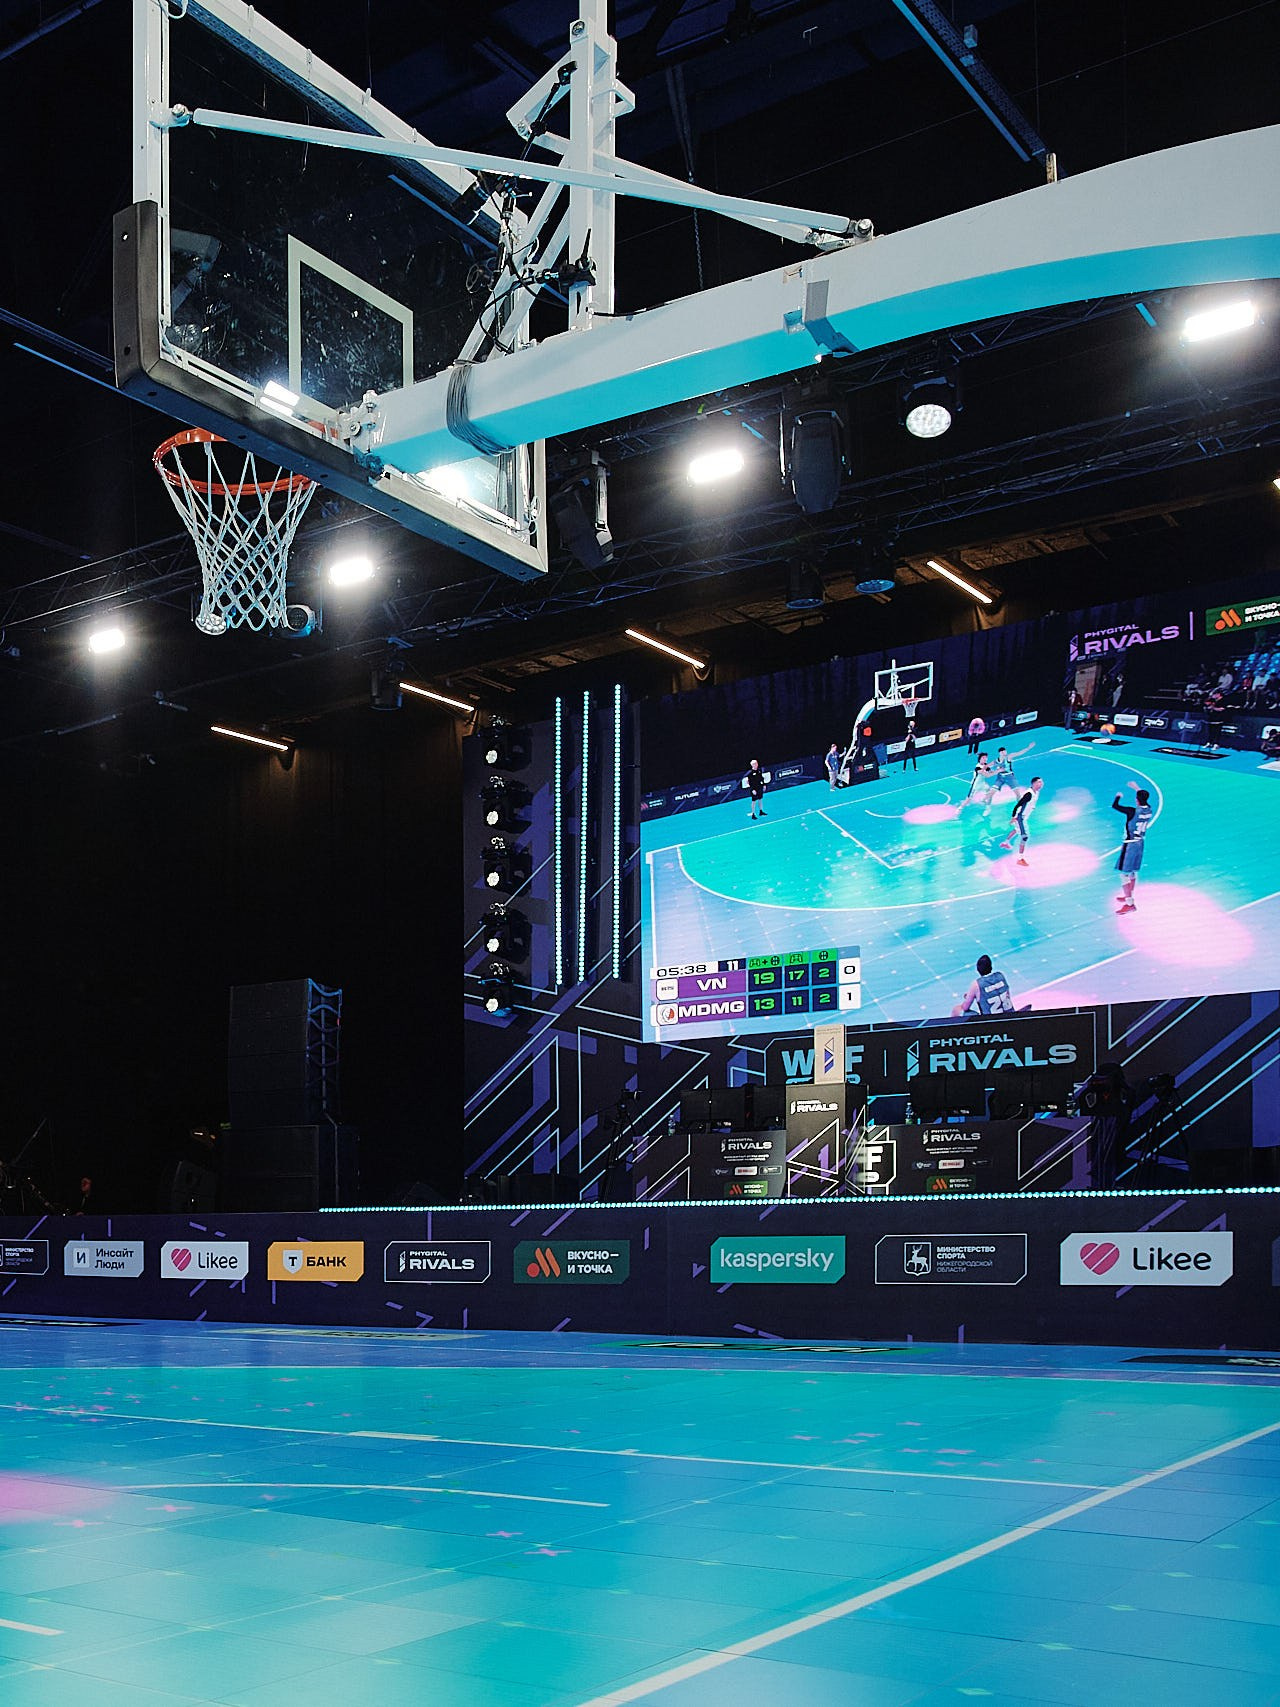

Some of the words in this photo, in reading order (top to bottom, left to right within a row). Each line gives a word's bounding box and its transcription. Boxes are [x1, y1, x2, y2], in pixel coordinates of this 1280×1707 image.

[1084, 624, 1139, 638] PHYGITAL
[1085, 625, 1180, 654] RIVALS
[657, 964, 707, 977] 05:38
[726, 960, 739, 971] 11
[696, 977, 727, 992] VN
[754, 972, 775, 985] 19
[788, 970, 805, 981] 17
[818, 968, 830, 978] 2
[844, 965, 856, 974] 0
[678, 1000, 745, 1018] MDMG
[754, 998, 775, 1010] 13
[791, 996, 803, 1006] 11
[819, 994, 831, 1004] 2
[929, 1033, 1015, 1048] PHYGITAL
[929, 1043, 1077, 1074] RIVALS
[728, 1141, 773, 1150] RIVALS
[931, 1133, 981, 1142] RIVALS
[76, 1252, 86, 1264] И
[95, 1248, 134, 1258] Инсайт
[197, 1252, 238, 1269] Likee
[306, 1256, 347, 1267] БАНК
[409, 1258, 475, 1270] RIVALS
[720, 1248, 834, 1272] kaspersky
[1133, 1247, 1212, 1271] Likee
[94, 1260, 125, 1270] Люди
[567, 1265, 576, 1274] И
[577, 1264, 613, 1274] ТОЧКА
